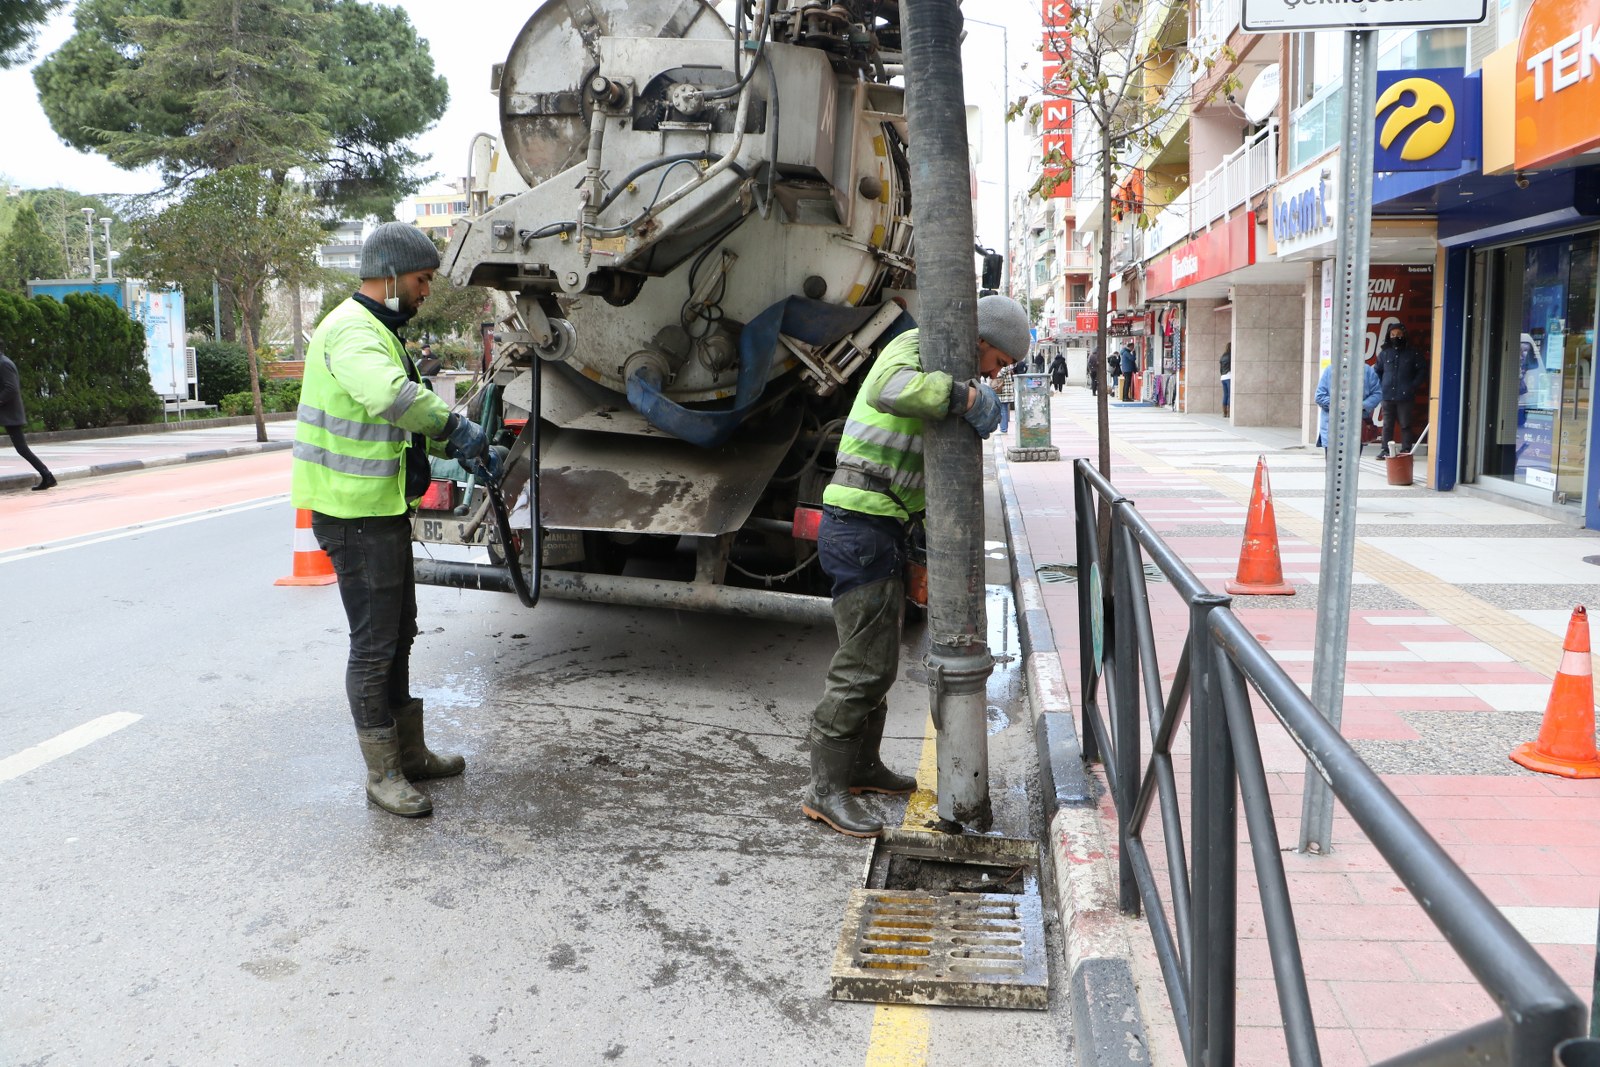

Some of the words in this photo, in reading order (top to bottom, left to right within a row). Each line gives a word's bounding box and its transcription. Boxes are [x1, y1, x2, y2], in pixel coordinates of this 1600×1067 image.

[1526, 24, 1600, 101] TEK
[423, 520, 443, 541] BC
[457, 523, 487, 543] 17
